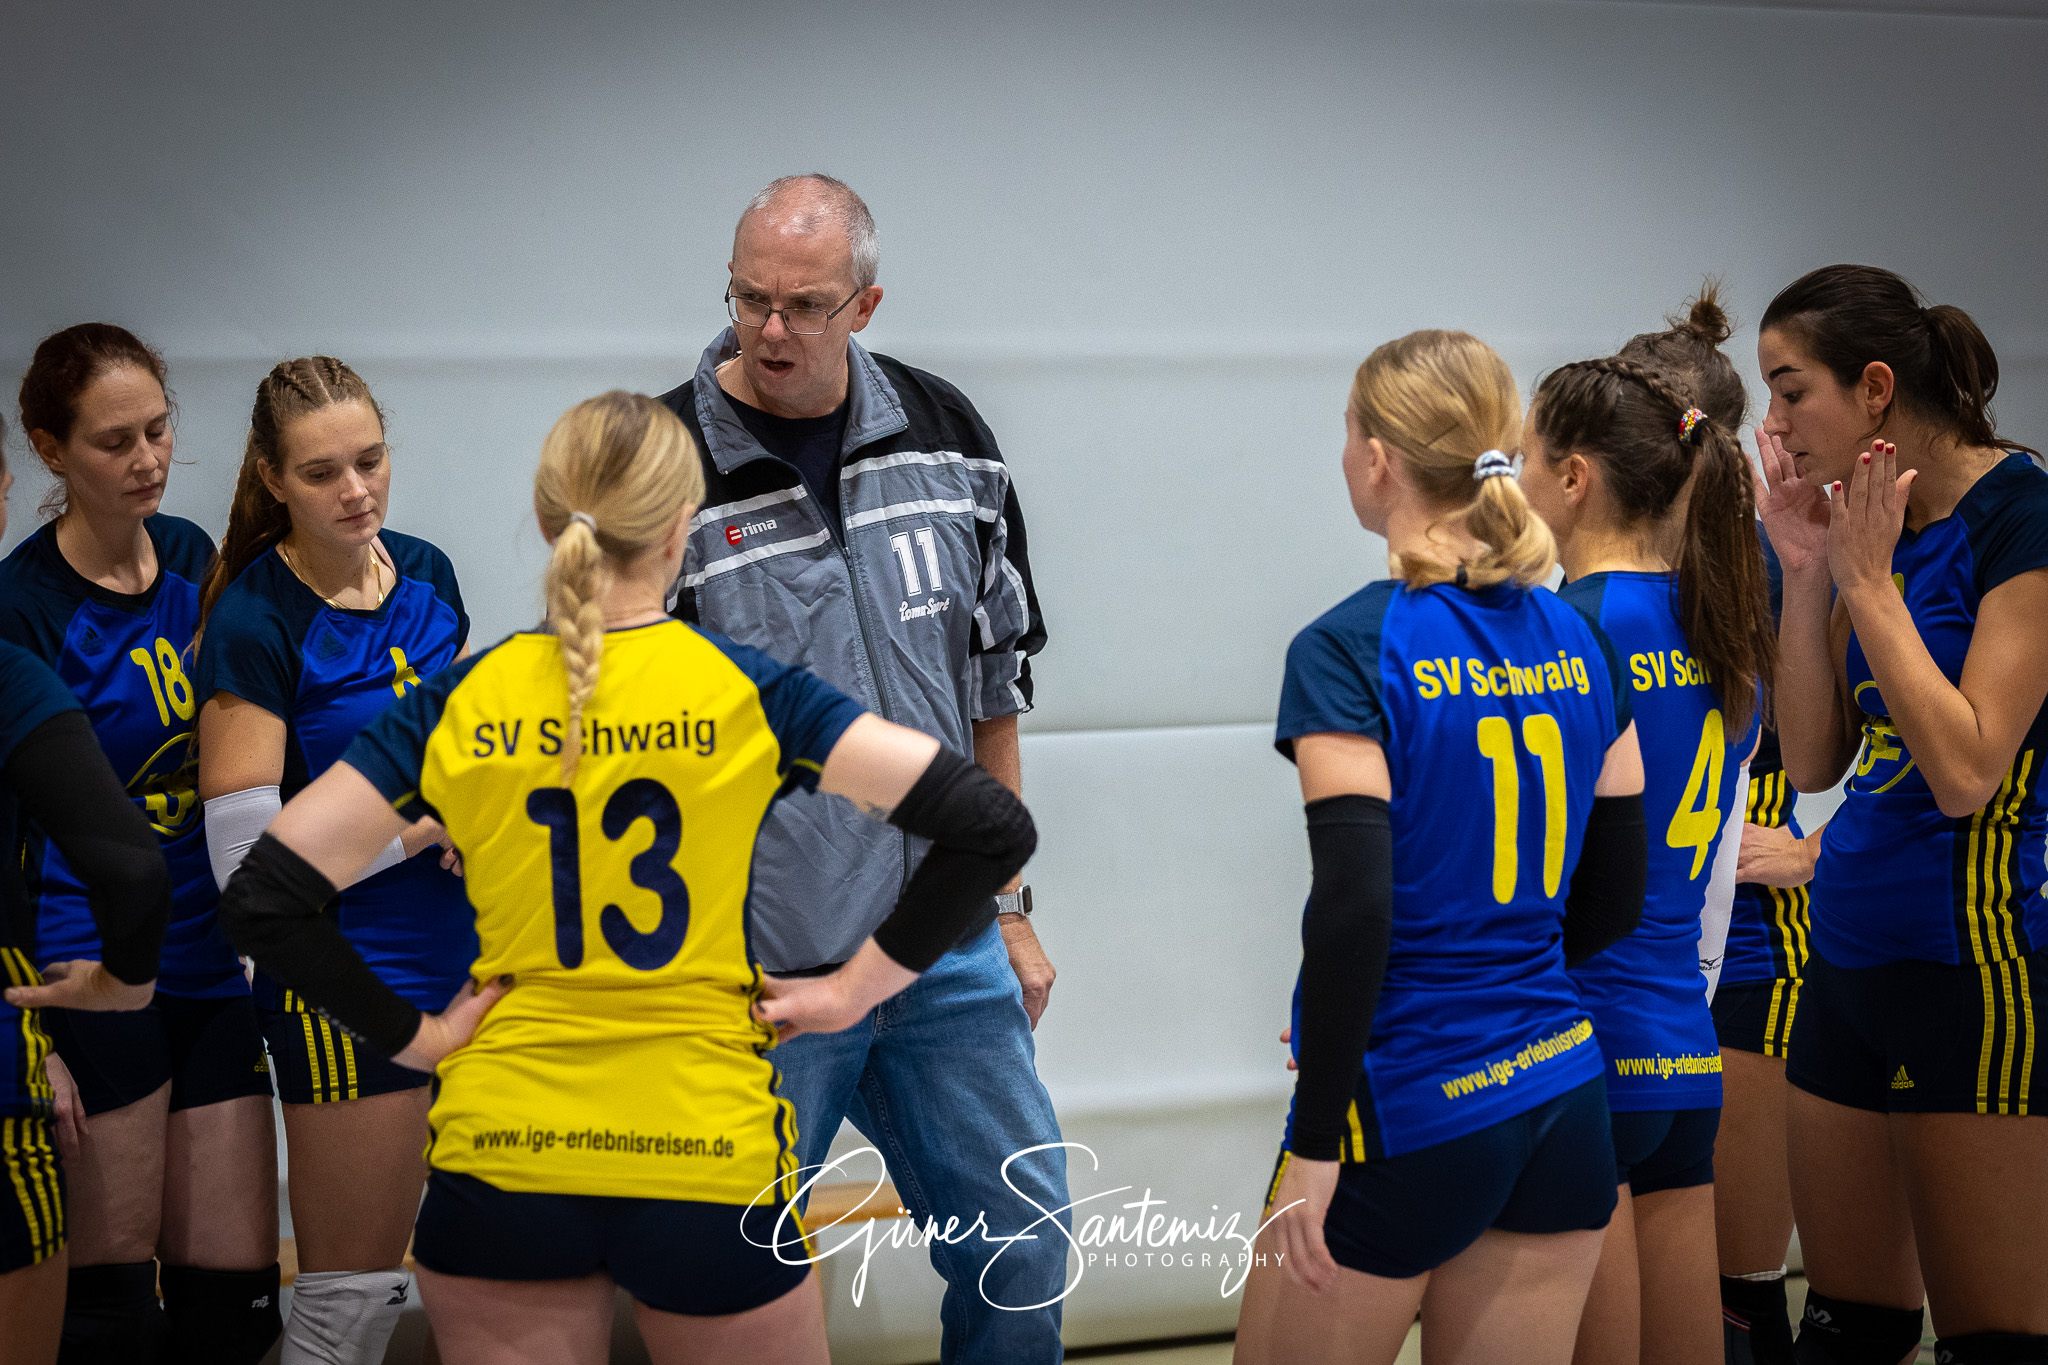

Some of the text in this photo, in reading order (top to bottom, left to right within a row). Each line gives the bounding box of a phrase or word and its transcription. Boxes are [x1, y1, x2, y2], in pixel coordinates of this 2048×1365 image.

[889, 527, 943, 596] 11
[130, 637, 196, 727] 18
[1413, 650, 1591, 699] SV Schwaig
[1628, 650, 1666, 691] SV
[474, 710, 715, 758] SV Shwaig
[1478, 714, 1567, 904] 11
[1666, 709, 1725, 881] 4
[526, 778, 690, 970] 13
[473, 1124, 734, 1158] www.ige-erlebnisreisen.de
